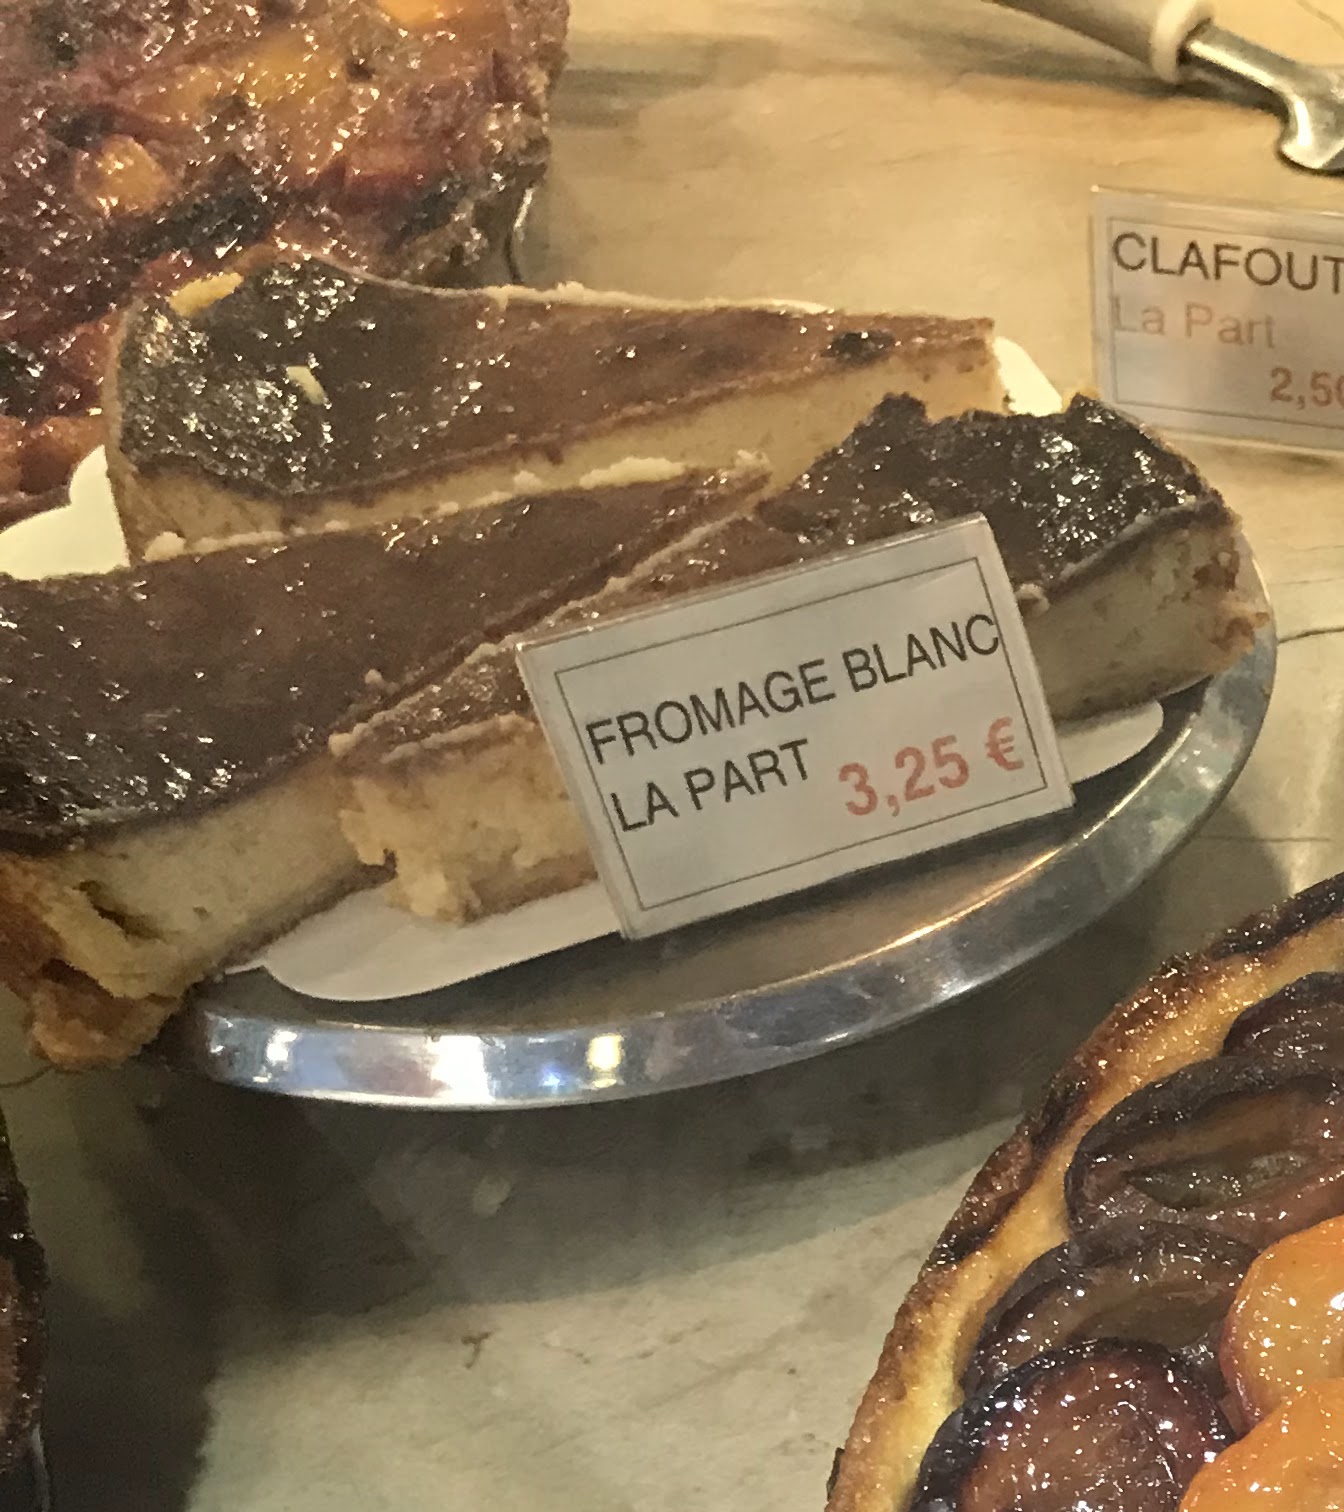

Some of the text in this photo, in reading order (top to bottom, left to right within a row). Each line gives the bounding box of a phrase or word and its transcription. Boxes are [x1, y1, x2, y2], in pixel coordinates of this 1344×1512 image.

[1114, 295, 1276, 350] La Part
[585, 613, 1001, 765] FROMAGE BLANC
[610, 716, 1026, 833] LA PART 3,25 €
